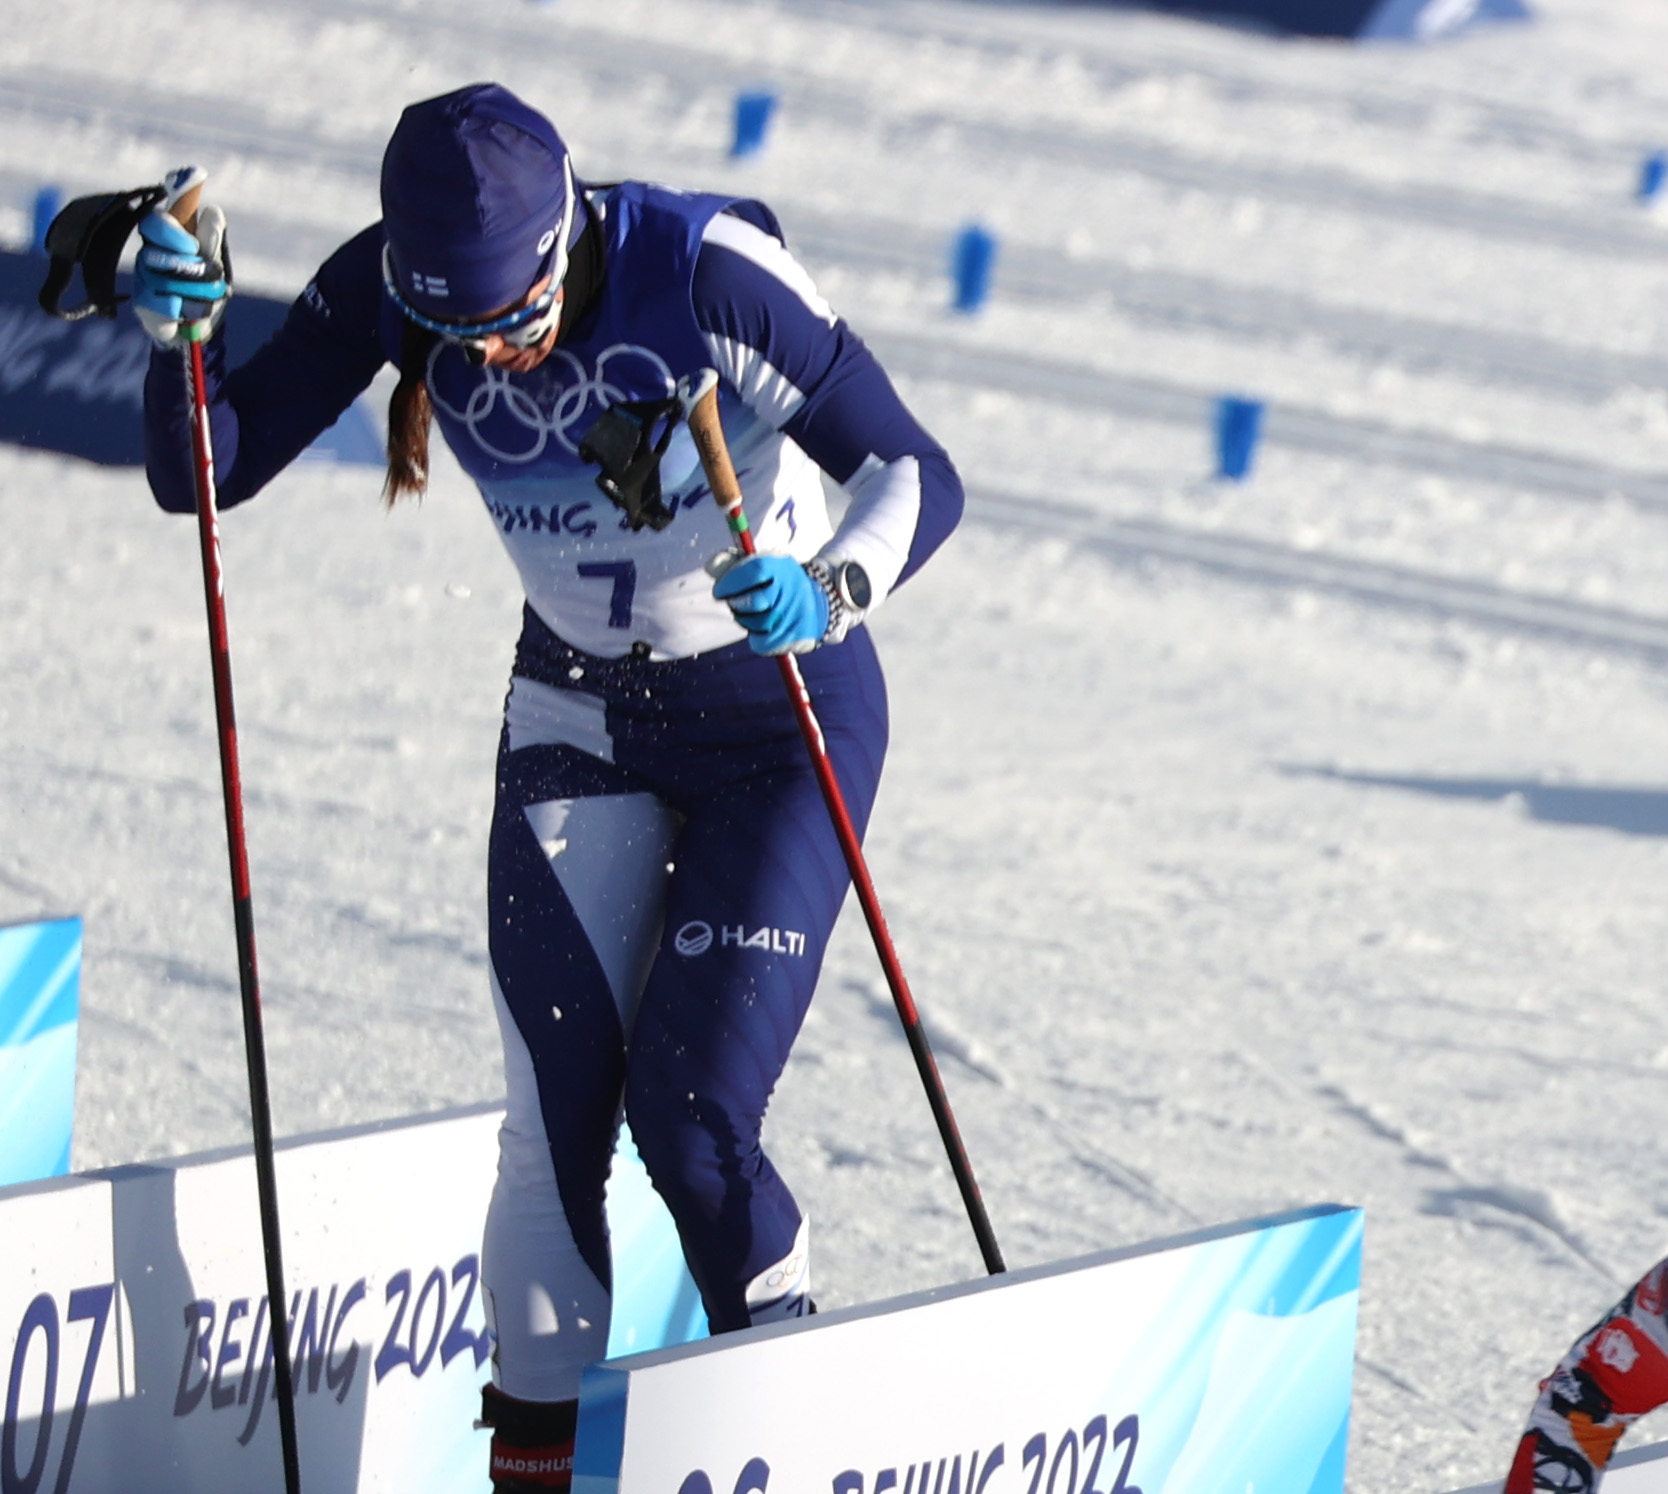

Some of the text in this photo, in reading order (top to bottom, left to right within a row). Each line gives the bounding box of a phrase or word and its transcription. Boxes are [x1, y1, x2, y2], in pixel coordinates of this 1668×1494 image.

[577, 558, 637, 629] 7
[721, 924, 806, 957] HALTI
[493, 1455, 574, 1474] MADSHUS
